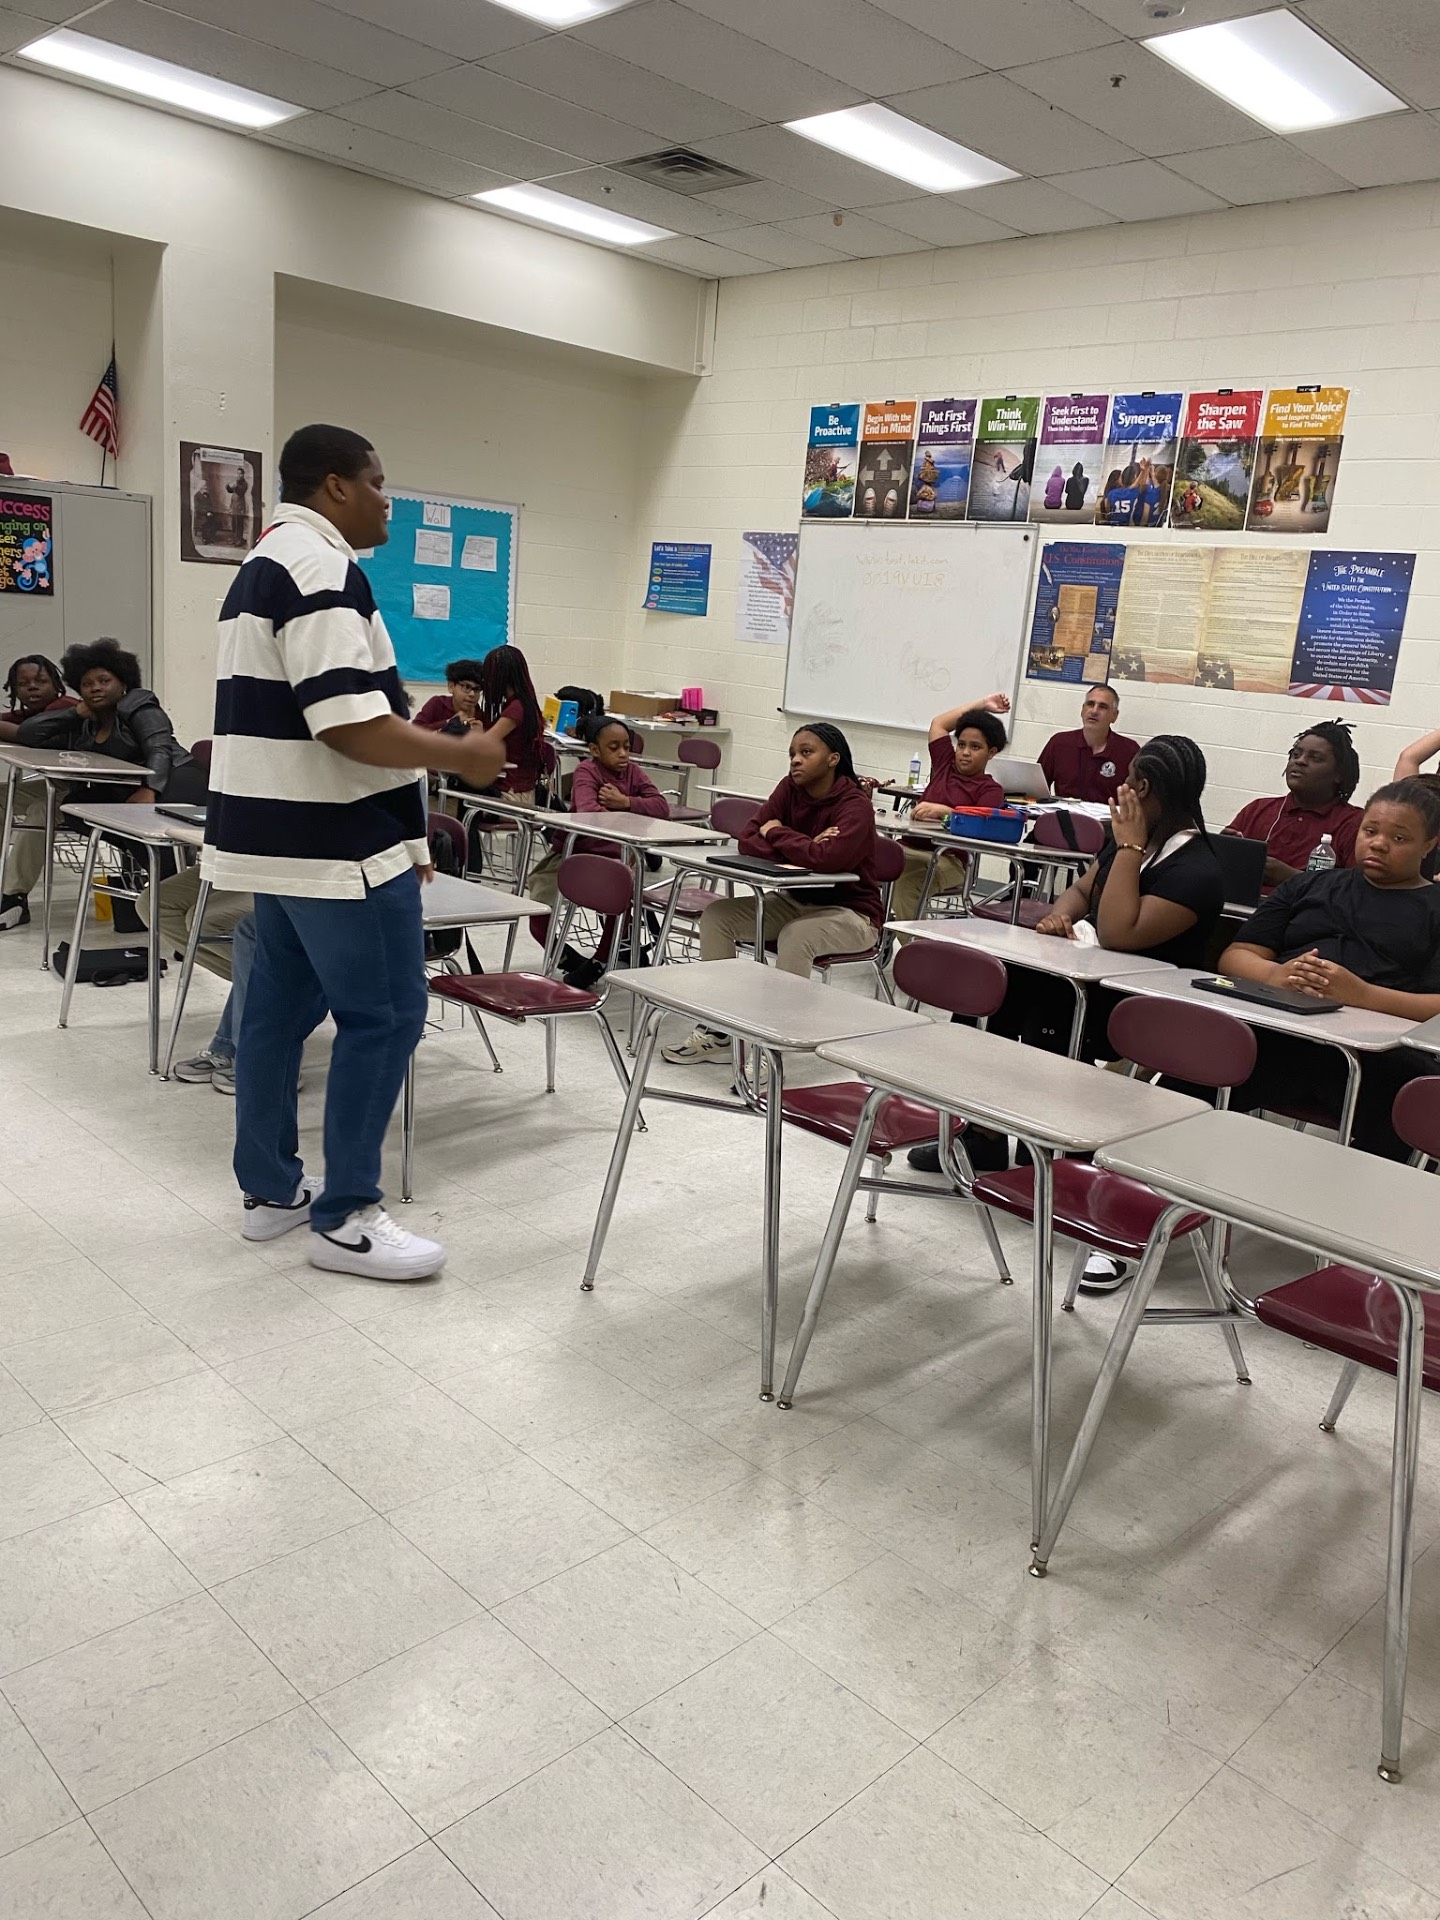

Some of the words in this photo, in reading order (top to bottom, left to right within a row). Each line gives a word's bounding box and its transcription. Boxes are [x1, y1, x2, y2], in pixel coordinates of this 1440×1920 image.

[996, 408, 1022, 420] Think
[1051, 406, 1070, 416] Seek
[1070, 406, 1089, 415] First
[1090, 406, 1100, 415] to
[1200, 403, 1247, 418] Sharpen
[1270, 404, 1291, 414] Find
[1292, 402, 1314, 413] Your
[1316, 402, 1343, 412] Voice
[828, 415, 839, 426] Be
[867, 414, 884, 424] Begin
[884, 413, 900, 422] With
[901, 412, 912, 422] the
[928, 410, 944, 422] Put
[944, 410, 966, 420] First
[1051, 416, 1098, 426] Understand,
[1118, 412, 1172, 428] Synergize
[865, 424, 880, 434] End
[880, 424, 889, 434] in
[890, 422, 912, 434] Mind
[922, 422, 949, 435] Things
[950, 421, 972, 432] First
[988, 420, 1027, 432] Win-Win
[1197, 418, 1215, 430] the
[1218, 417, 1243, 430] Saw
[814, 425, 852, 436] Proactive
[1115, 500, 1130, 513] 15
[425, 508, 445, 524] Wall
[33, 522, 47, 531] on
